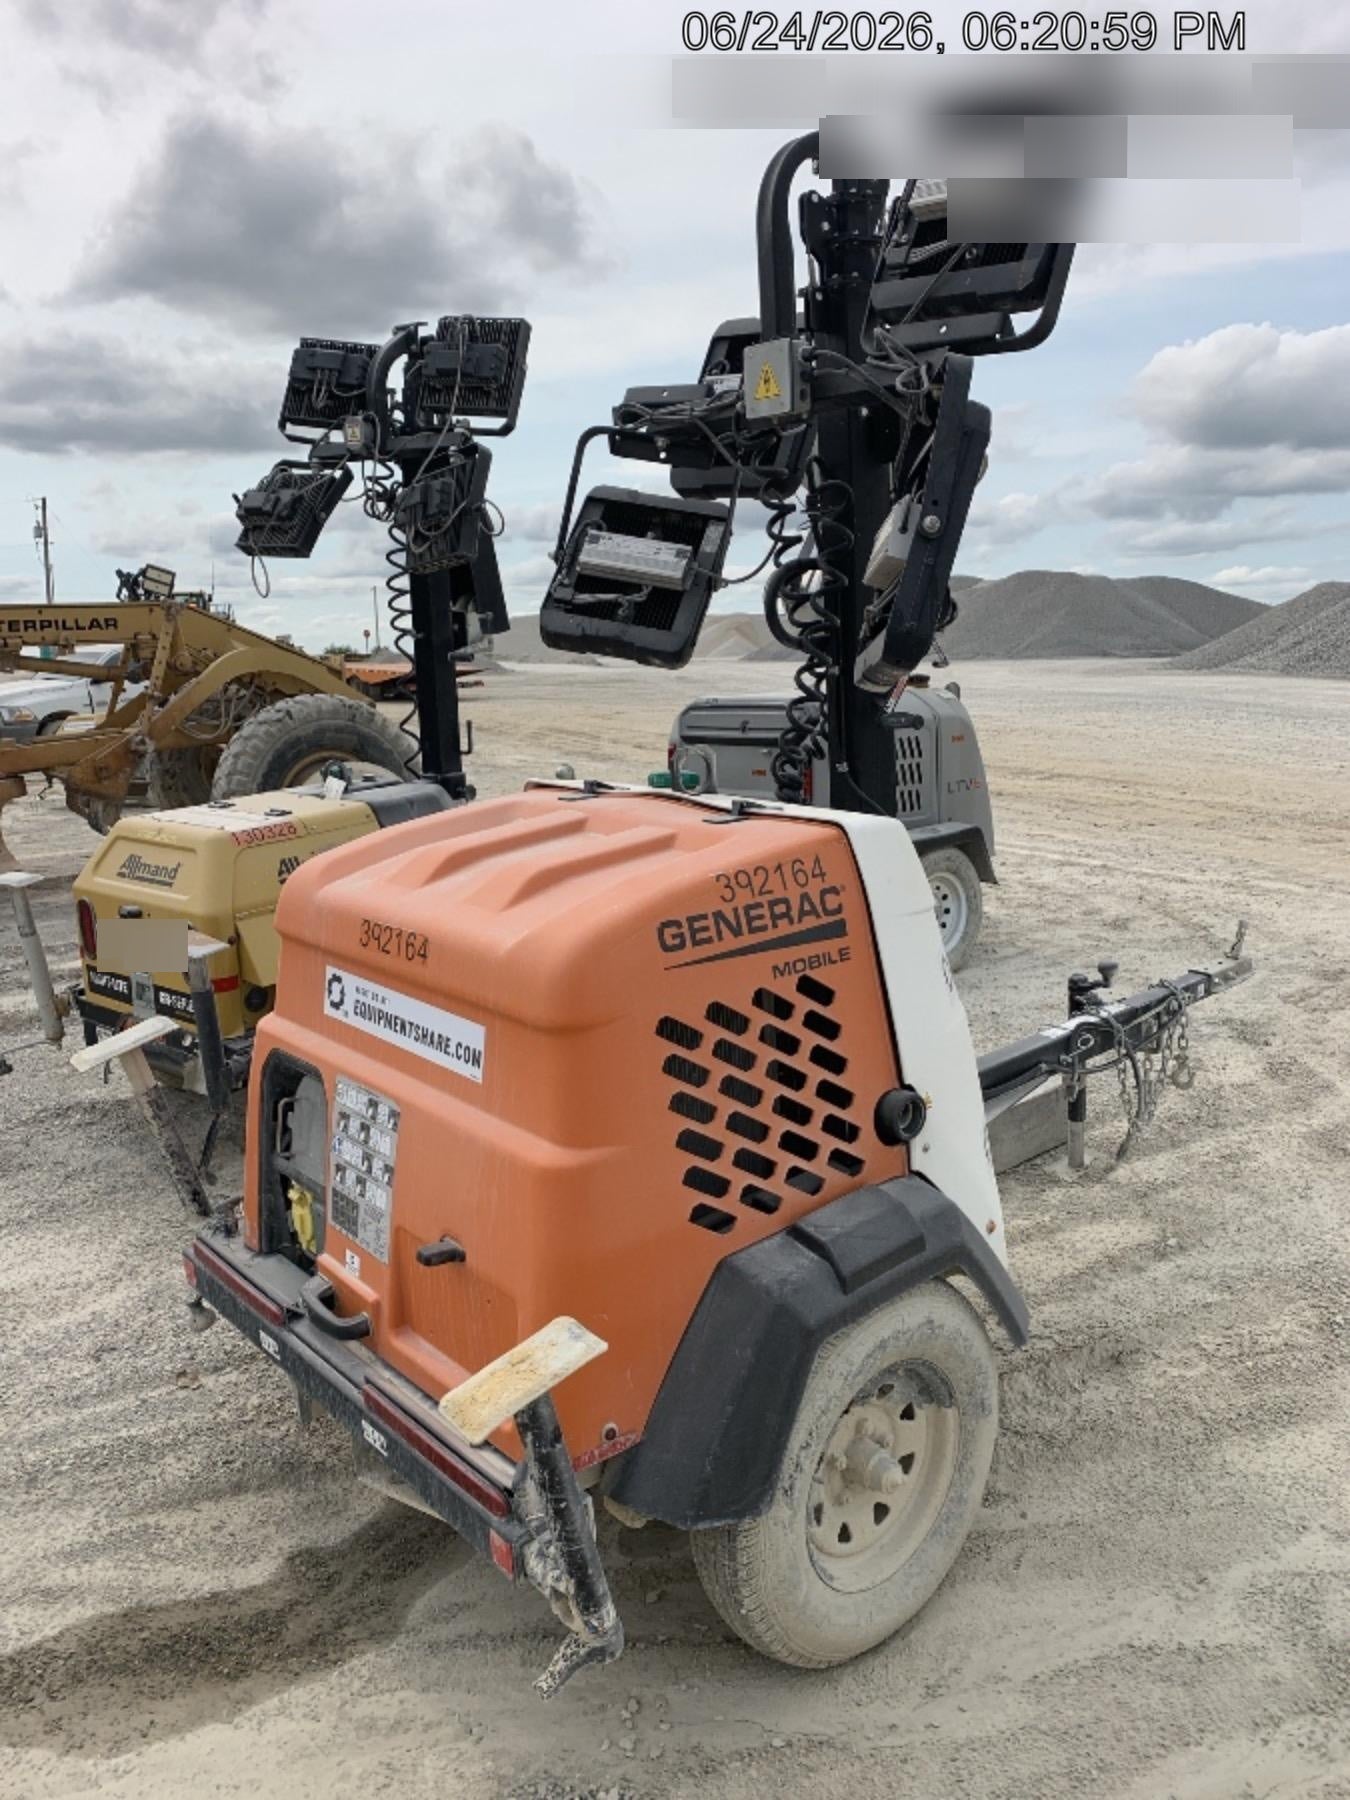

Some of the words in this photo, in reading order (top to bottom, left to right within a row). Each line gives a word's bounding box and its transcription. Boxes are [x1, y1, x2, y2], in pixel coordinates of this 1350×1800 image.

[119, 853, 181, 881] Allmand
[715, 854, 827, 904] 392164
[359, 918, 430, 965] 392164
[657, 885, 844, 953] GENERAC
[772, 946, 852, 980] MOBILE
[353, 999, 483, 1069] EQUIPMENTSHARE.COM
